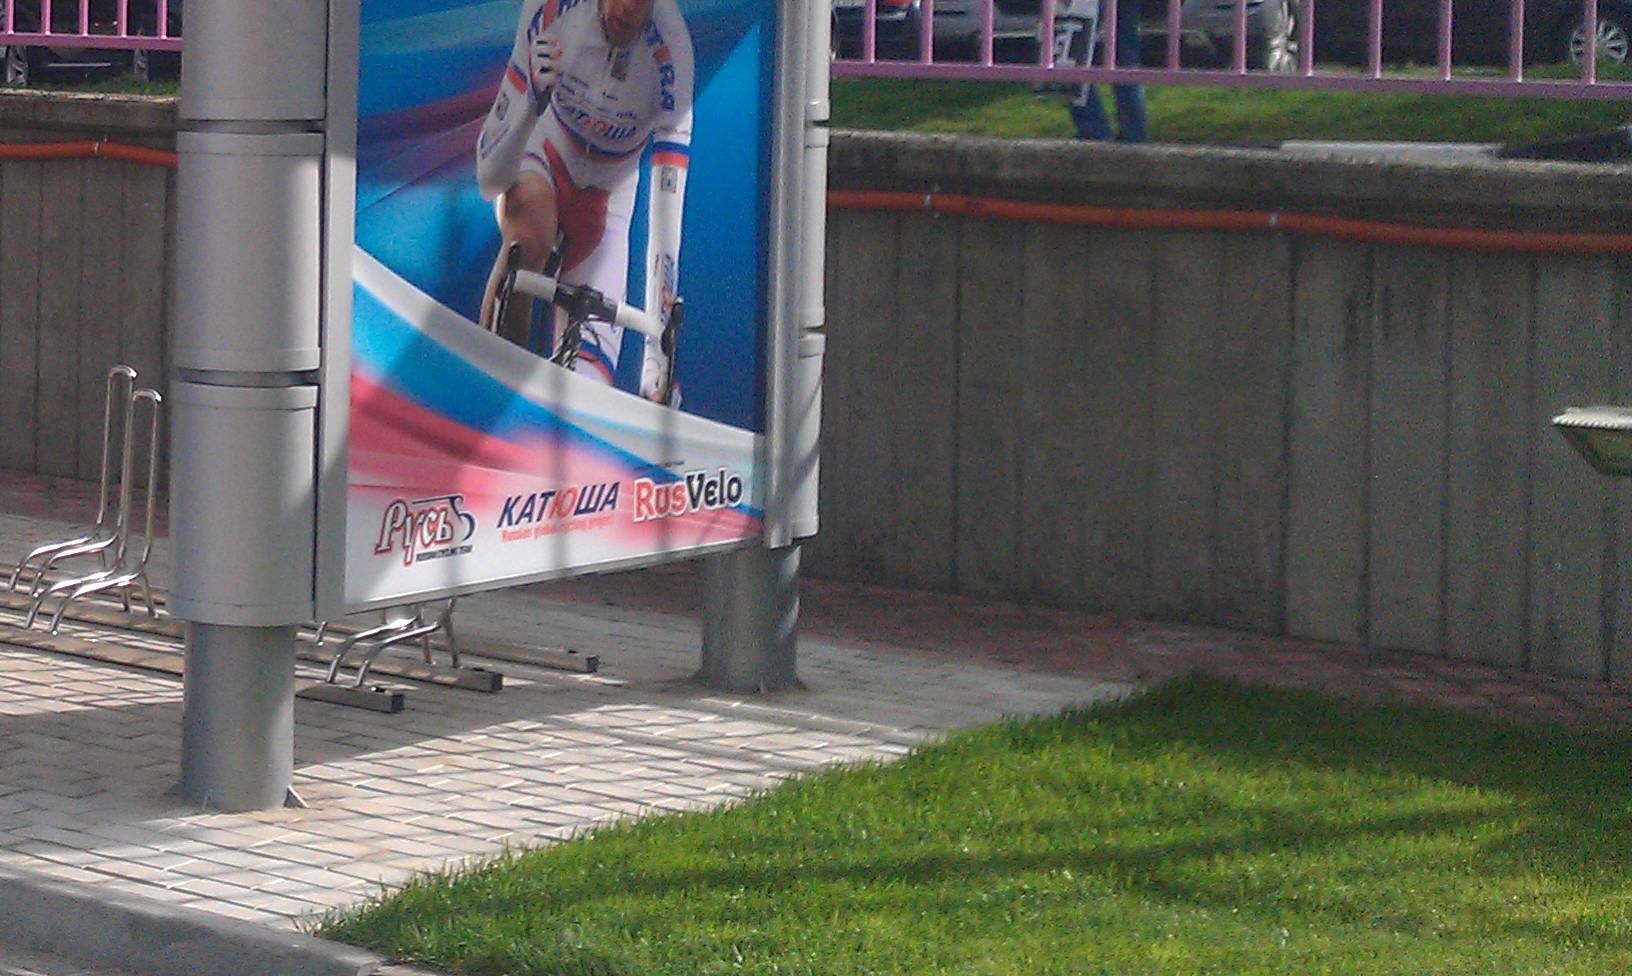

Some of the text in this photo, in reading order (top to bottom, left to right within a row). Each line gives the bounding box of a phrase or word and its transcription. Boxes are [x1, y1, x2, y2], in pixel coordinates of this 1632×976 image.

[497, 482, 620, 528] КАТЮША
[634, 468, 743, 522] RusVelo
[375, 497, 458, 567] Русь
